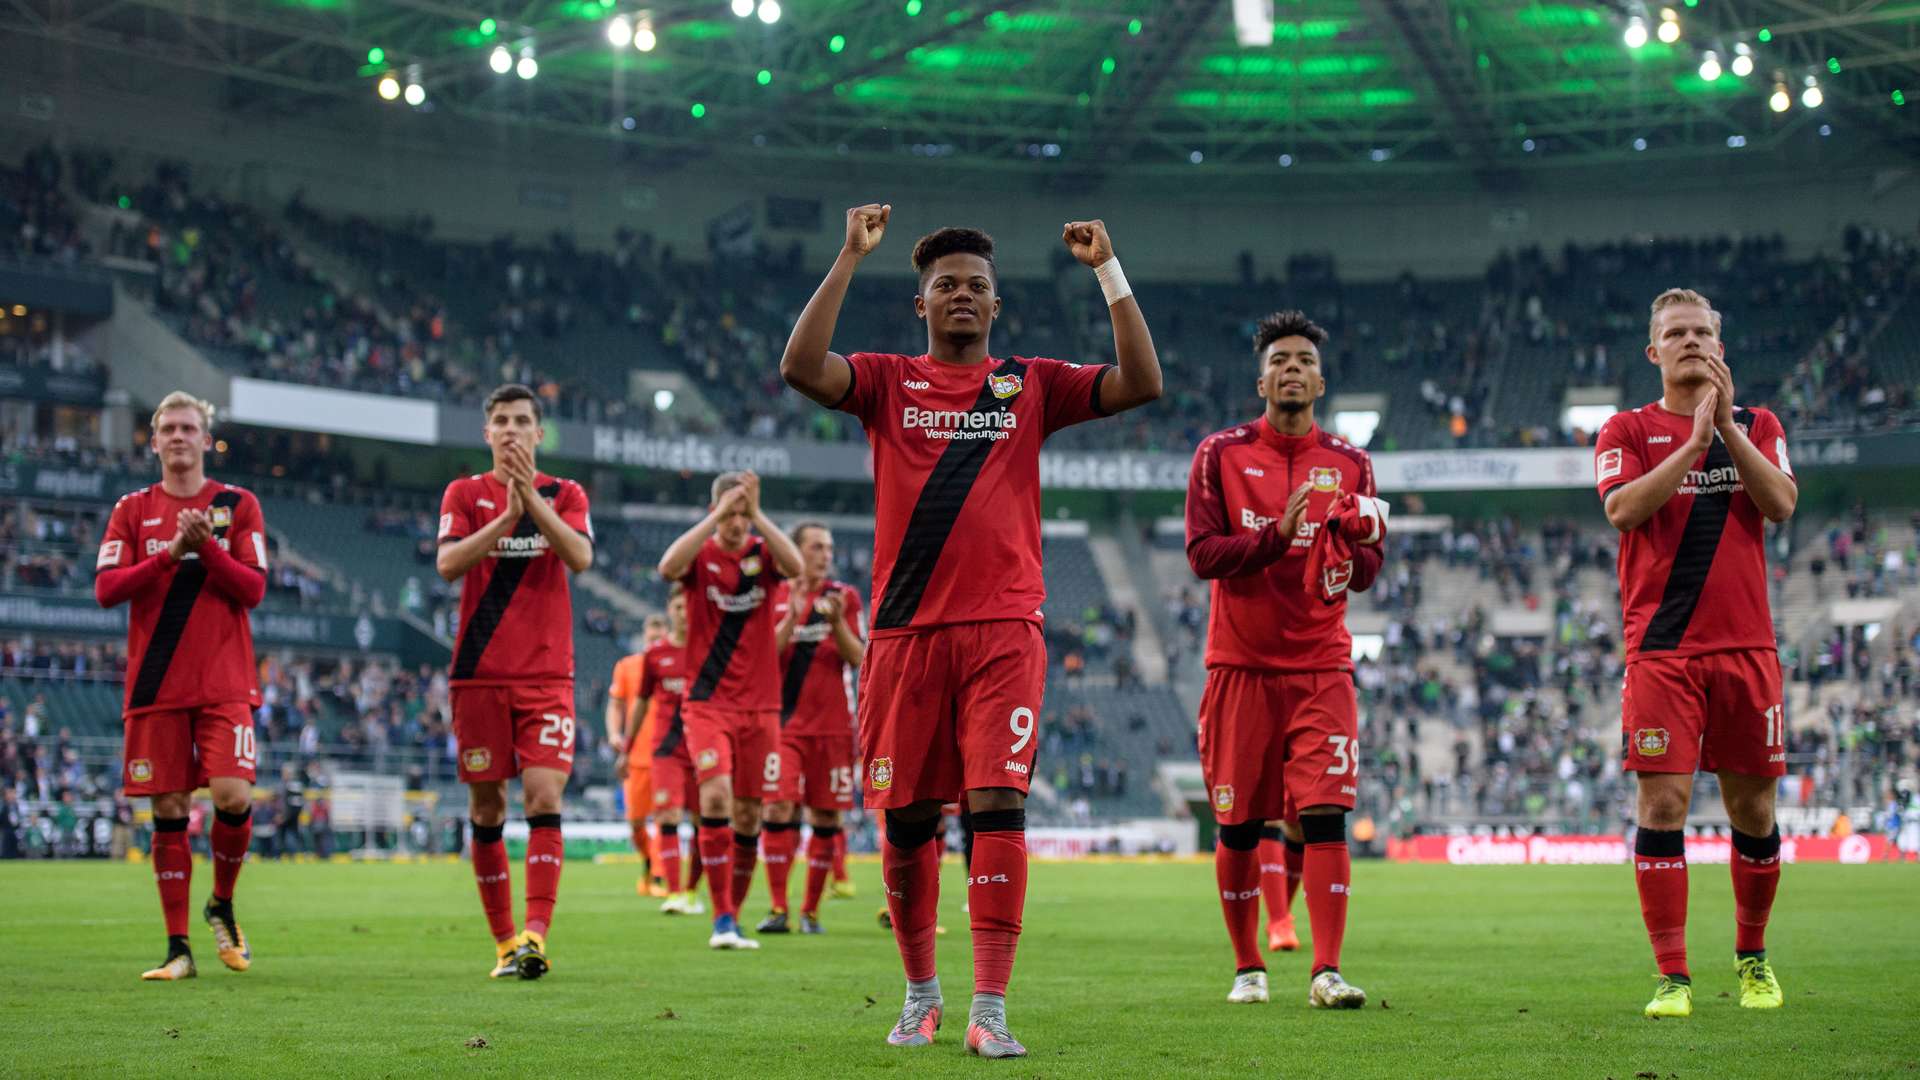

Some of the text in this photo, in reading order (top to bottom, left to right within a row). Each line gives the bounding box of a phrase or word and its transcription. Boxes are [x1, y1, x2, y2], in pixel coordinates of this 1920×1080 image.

[903, 379, 930, 390] JAKO
[903, 406, 1017, 429] Barmenia
[924, 428, 1009, 441] Versicherungen
[593, 426, 792, 476] H-Hotels.com
[232, 723, 256, 761] 10
[539, 713, 575, 749] 29
[1010, 707, 1034, 754] 9
[763, 752, 782, 782] 8
[1005, 760, 1028, 775] JAKO
[1326, 735, 1360, 778] 39
[830, 766, 853, 794] 15
